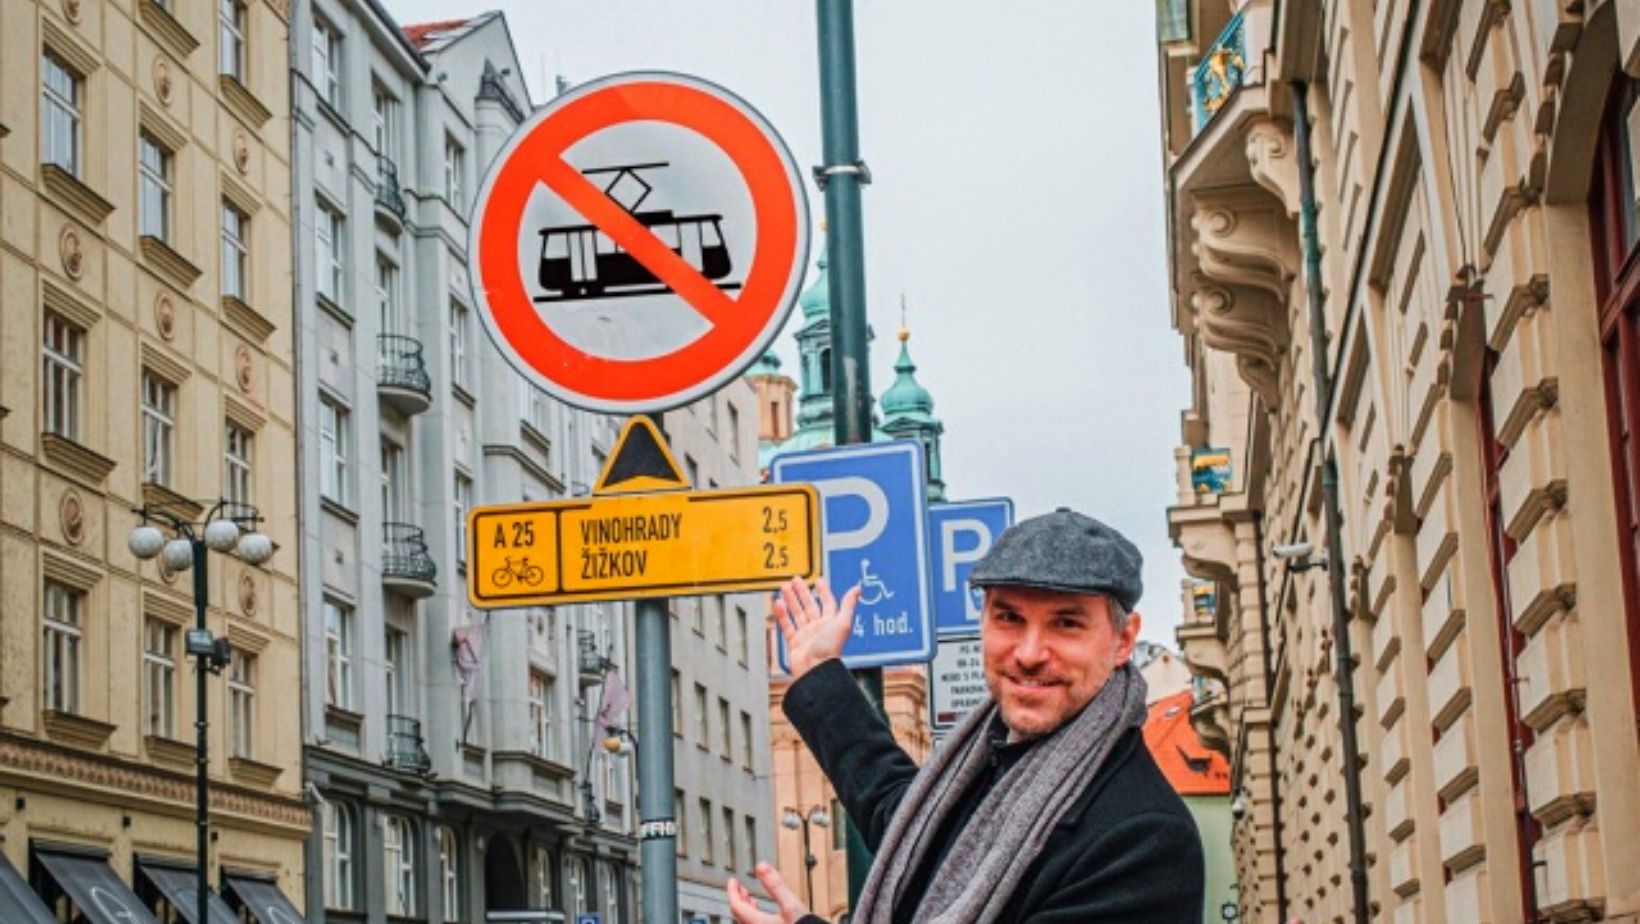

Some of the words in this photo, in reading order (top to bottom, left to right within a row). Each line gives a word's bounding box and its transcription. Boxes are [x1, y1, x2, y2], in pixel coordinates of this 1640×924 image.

[494, 522, 507, 549] A
[512, 520, 535, 548] 25
[580, 512, 682, 545] VINOHRADY
[580, 547, 648, 579] ŽIŽKOV
[941, 518, 993, 592] P
[873, 610, 914, 636] hod.
